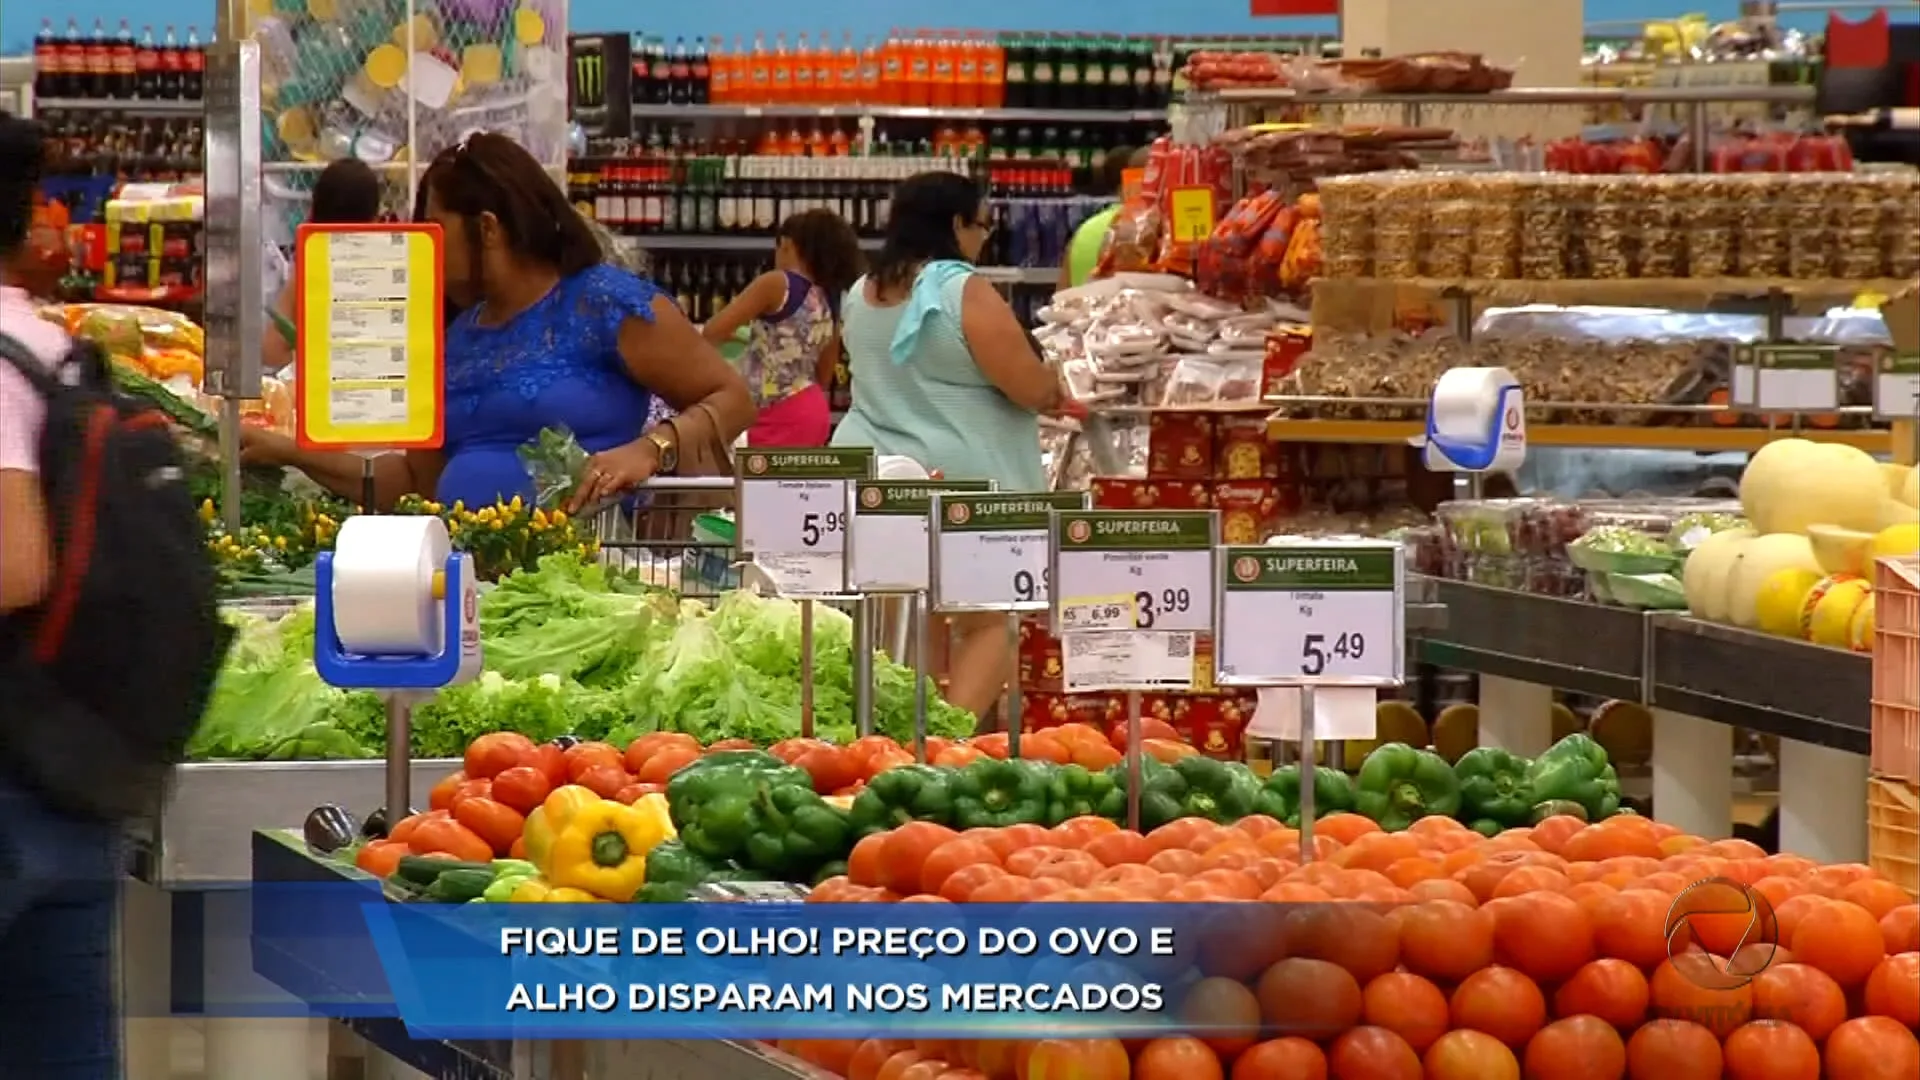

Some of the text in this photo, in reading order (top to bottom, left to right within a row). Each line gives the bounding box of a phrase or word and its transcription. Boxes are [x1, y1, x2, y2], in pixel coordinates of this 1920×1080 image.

[771, 455, 841, 467] SUPERFEIRA
[975, 502, 1053, 515] SUPERFEIRA
[1095, 520, 1180, 535] SUPERFEIRA
[1265, 556, 1359, 572] SUPERFEIRA
[1135, 588, 1190, 629] 3,99
[1299, 605, 1313, 617] Kg
[1300, 631, 1365, 676] 5,49
